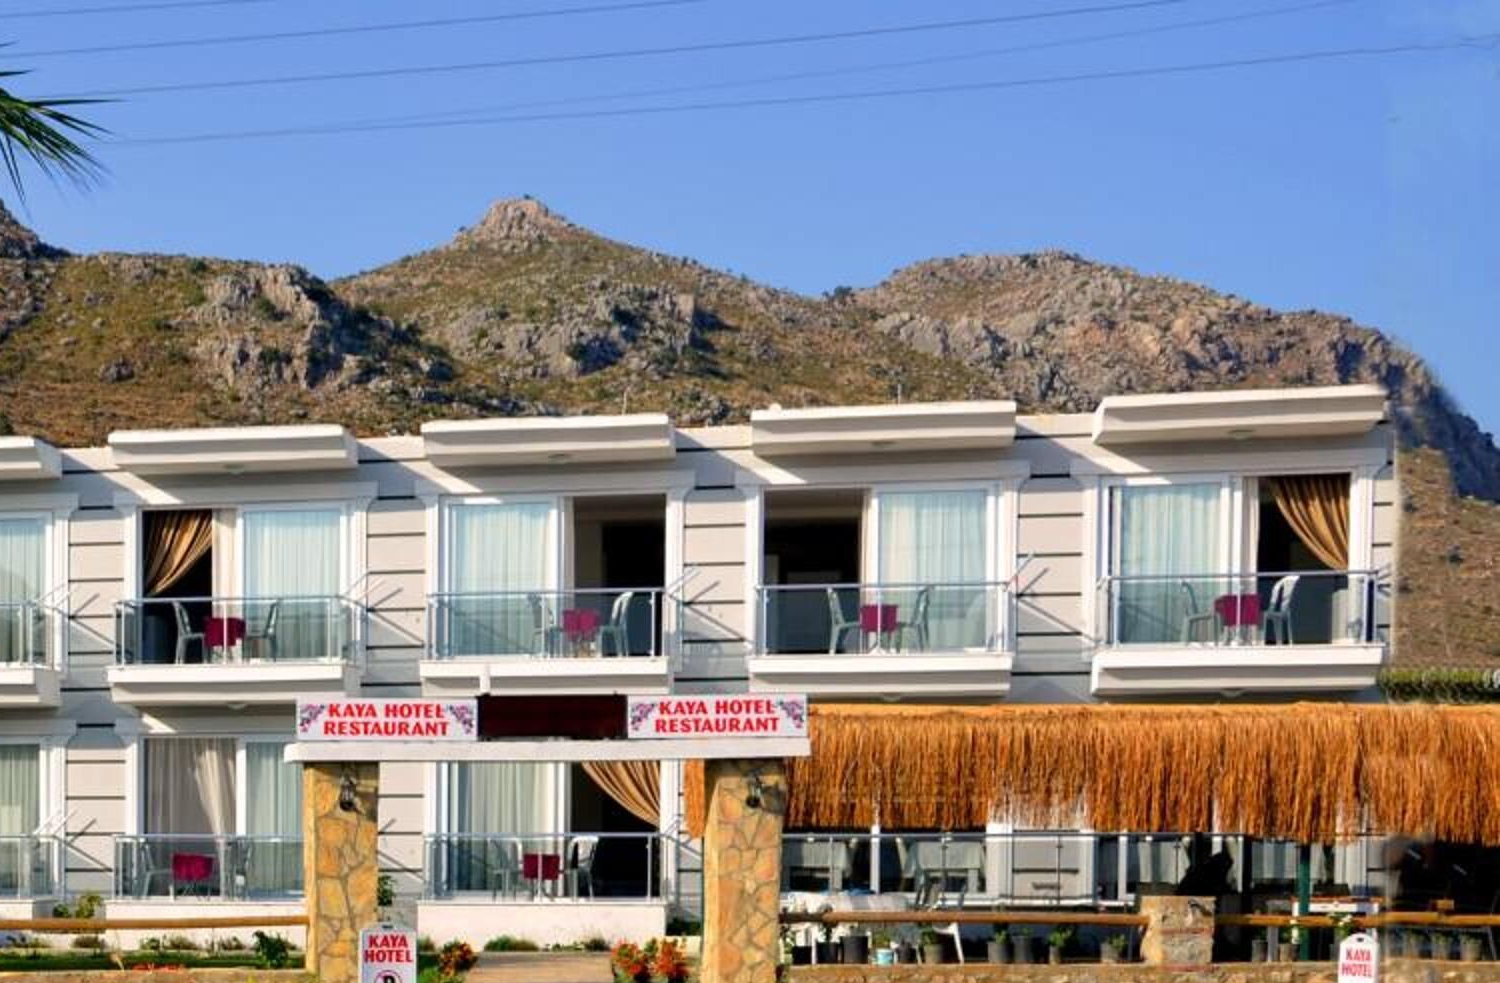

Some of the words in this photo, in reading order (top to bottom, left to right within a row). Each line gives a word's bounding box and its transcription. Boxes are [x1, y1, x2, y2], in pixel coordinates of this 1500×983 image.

[328, 703, 377, 718] KAYA
[384, 703, 445, 718] HOTEL
[659, 700, 708, 715] KAYA
[715, 699, 775, 714] HOTEL
[323, 721, 449, 736] RESTAURANT
[654, 717, 780, 733] RESTAURANT
[368, 934, 408, 948] KAYA
[364, 950, 413, 963] HOTEL
[1345, 949, 1372, 961] KAYA
[1341, 963, 1373, 977] HOTEL
